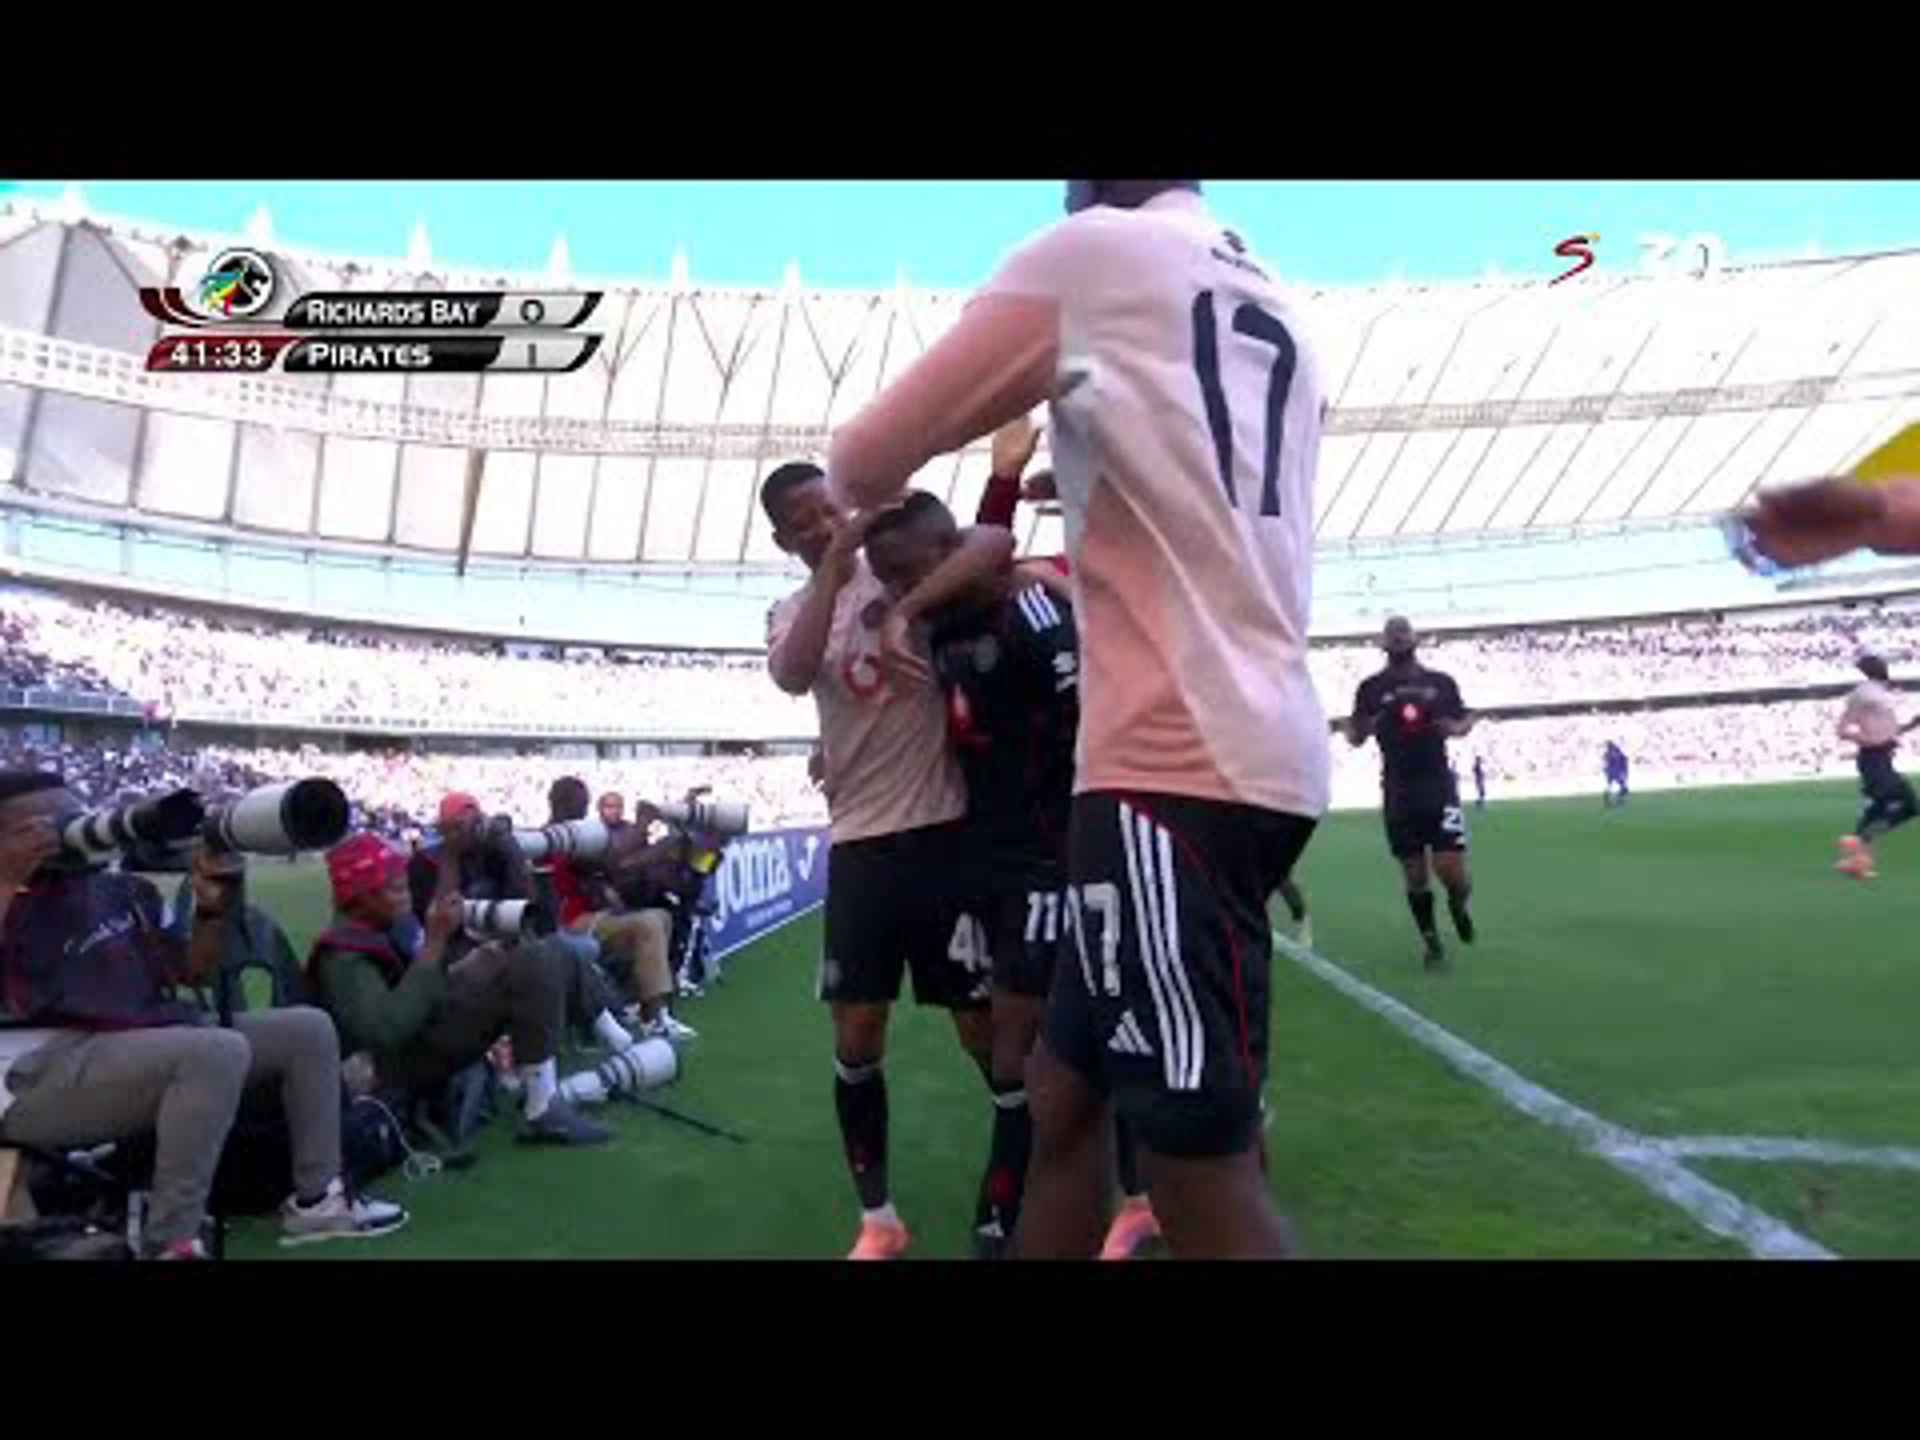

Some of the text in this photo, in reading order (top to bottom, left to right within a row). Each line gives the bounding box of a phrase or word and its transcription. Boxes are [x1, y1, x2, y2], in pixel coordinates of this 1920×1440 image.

[1193, 290, 1296, 517] 17
[1024, 891, 1059, 941] 11
[1063, 883, 1120, 997] 17
